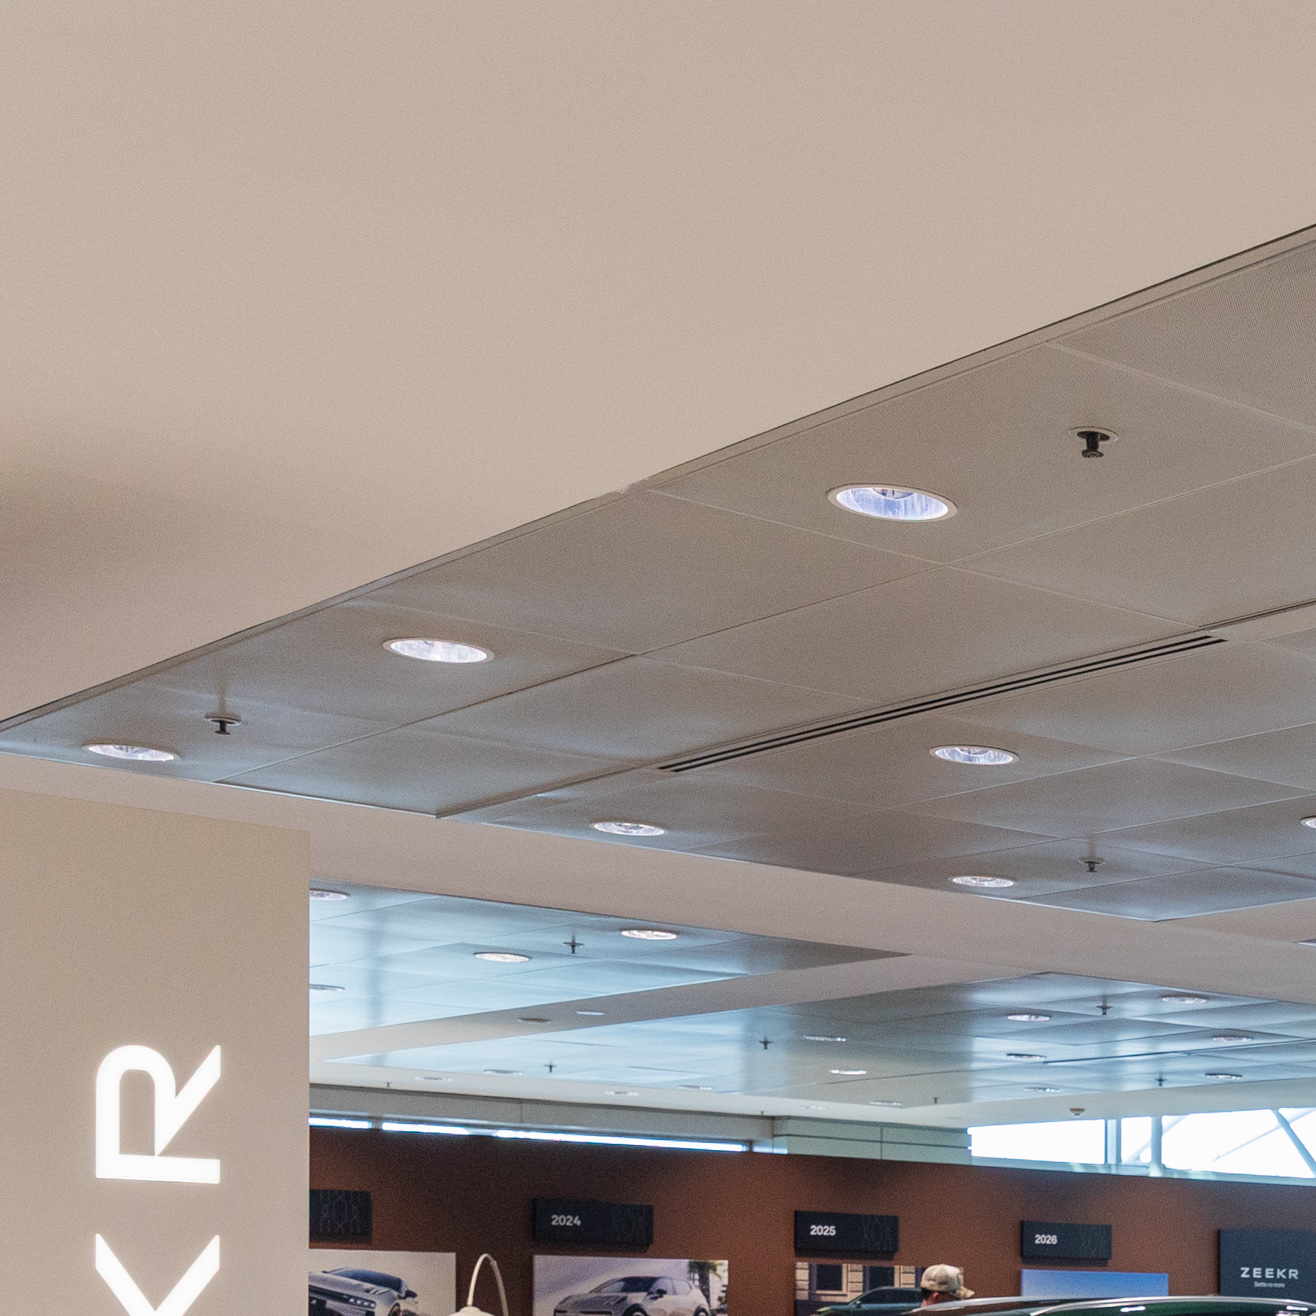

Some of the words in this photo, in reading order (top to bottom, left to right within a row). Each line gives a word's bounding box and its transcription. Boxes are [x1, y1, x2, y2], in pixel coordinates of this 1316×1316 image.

[551, 1214, 581, 1227] 2024
[810, 1224, 836, 1236] 2025
[1034, 1233, 1058, 1245] 2026
[1241, 1266, 1299, 1280] ZEEKR
